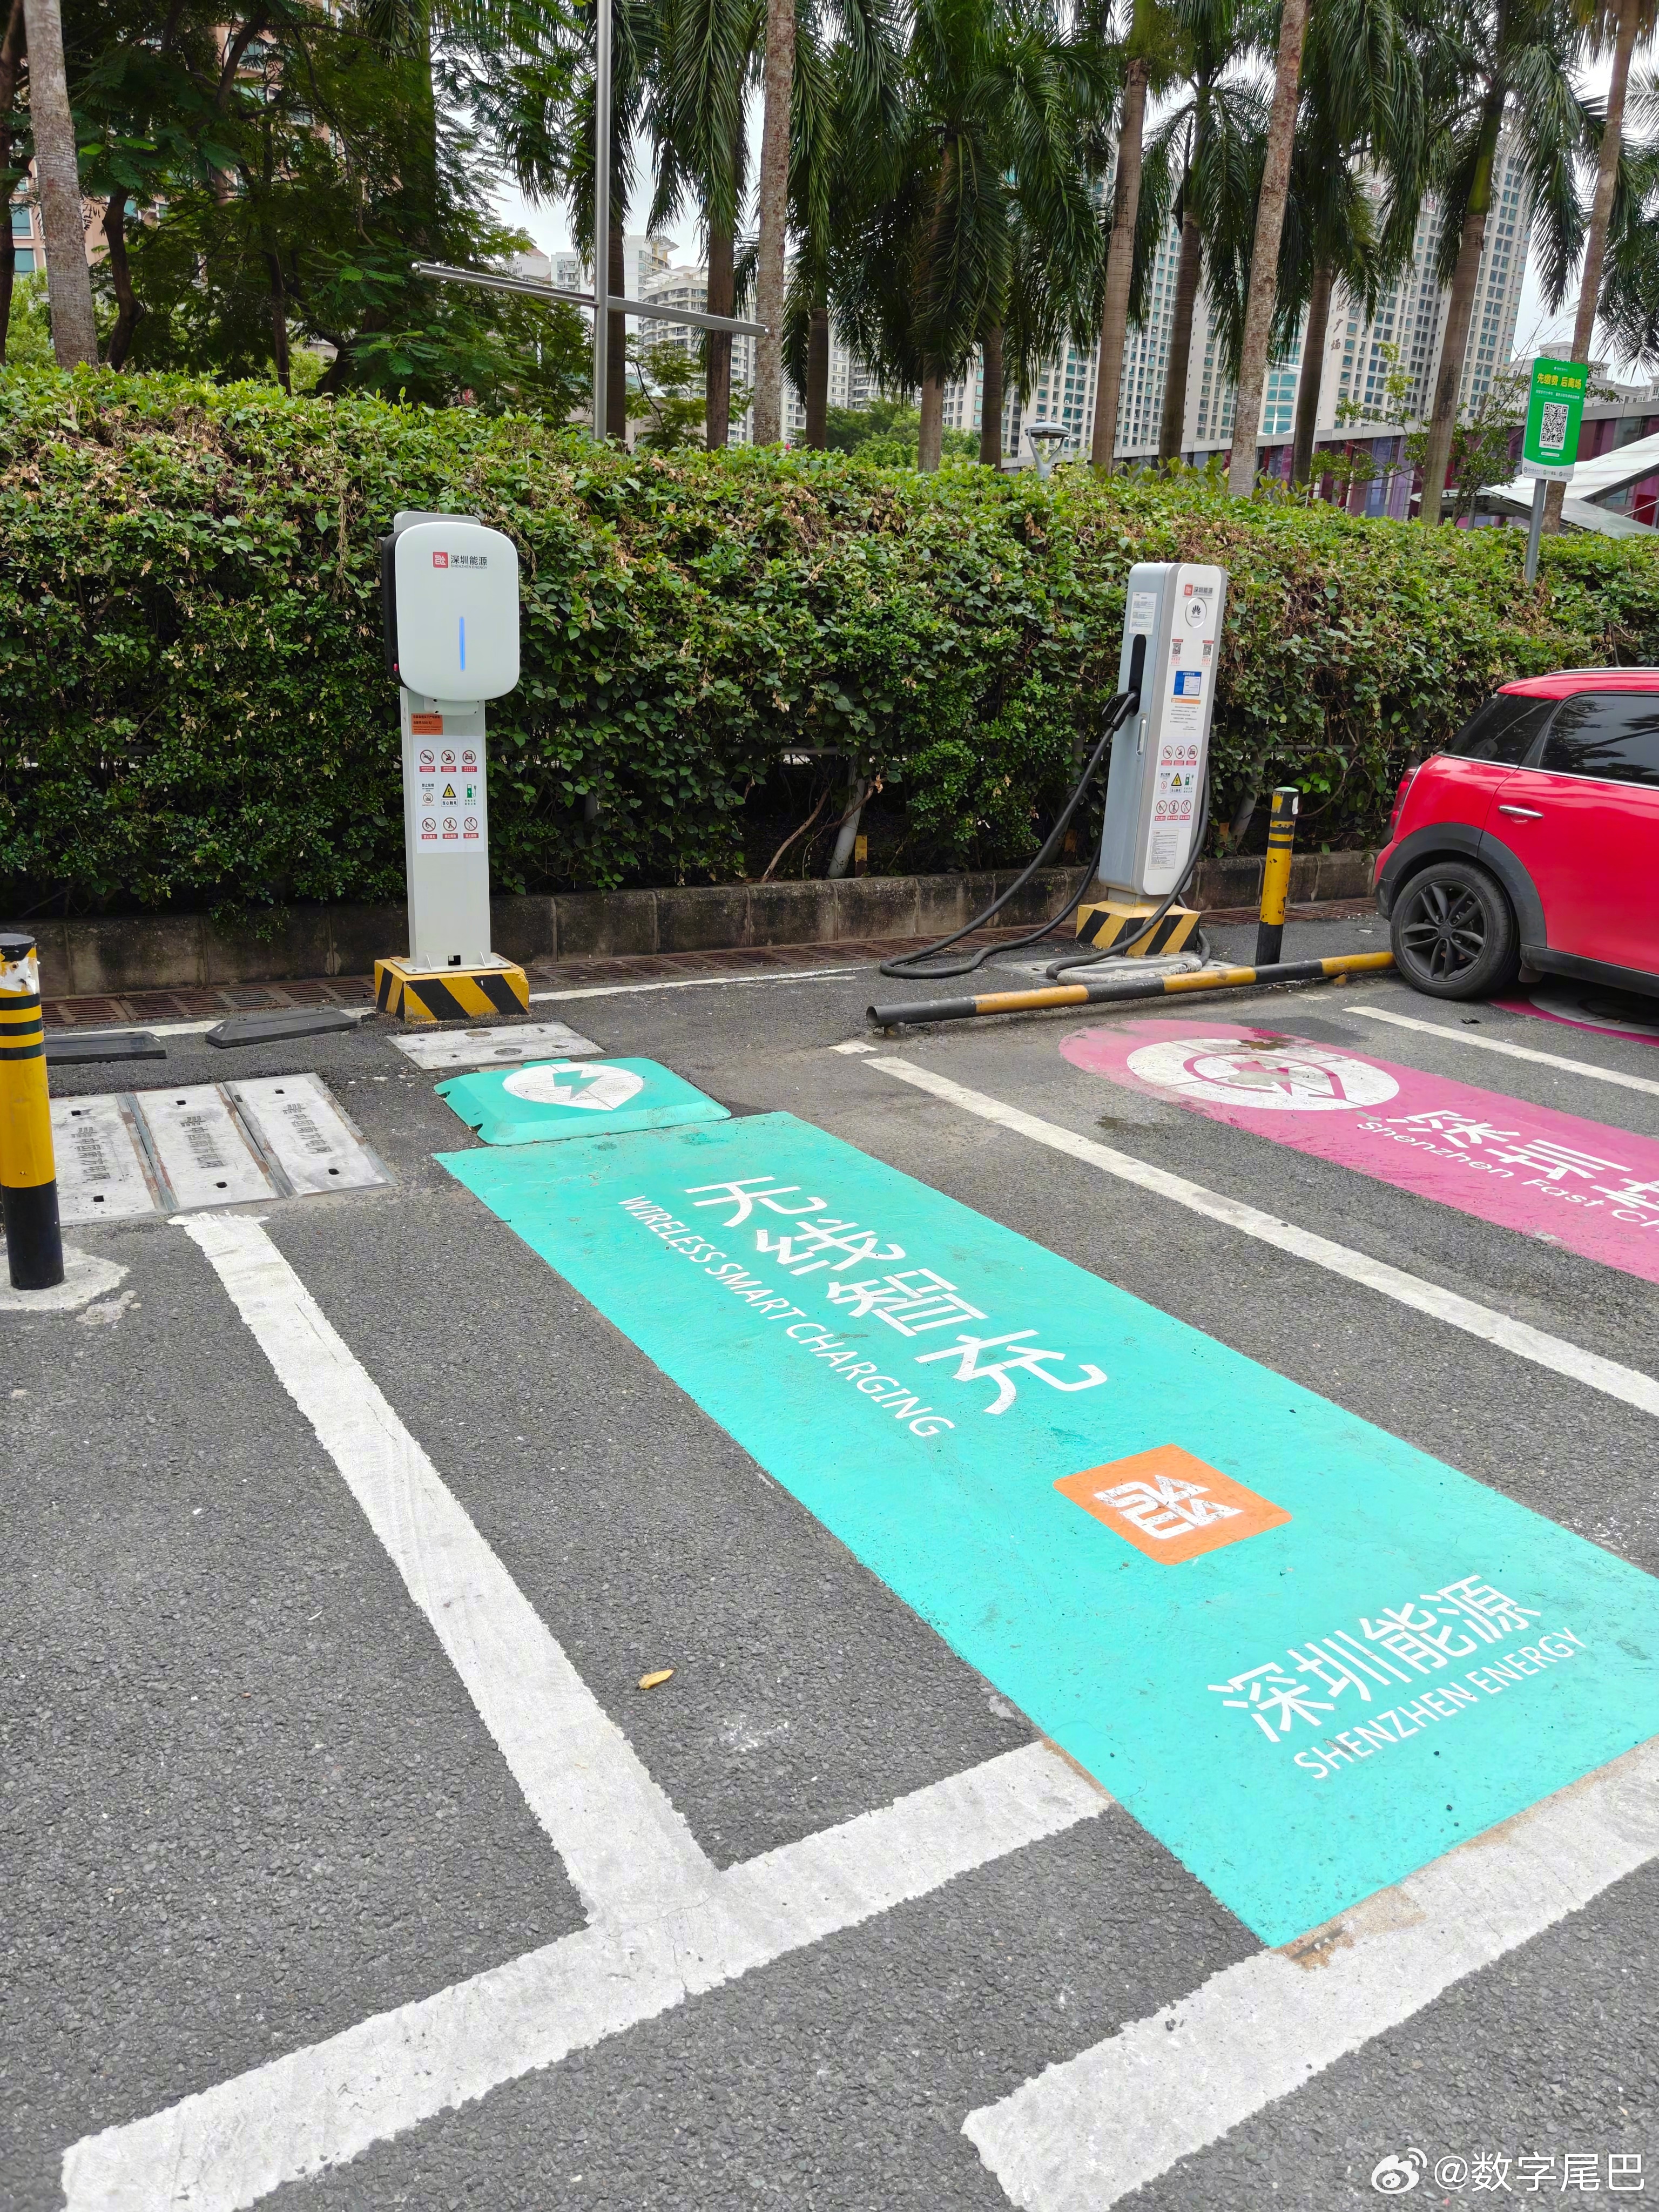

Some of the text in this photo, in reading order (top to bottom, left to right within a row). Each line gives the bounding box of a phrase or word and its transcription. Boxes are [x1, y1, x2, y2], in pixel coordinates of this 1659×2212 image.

[1561, 377, 1582, 389] 后离场
[451, 555, 487, 566] 深圳能源
[184, 1127, 224, 1168] 中国南方电网
[288, 1114, 332, 1154] 中国南方电网
[74, 1138, 111, 1181] 中国南方电网
[1357, 1122, 1515, 1178] Shenzhen
[1521, 1179, 1605, 1207] Fast
[618, 1196, 956, 1437] WIRELESS SMART CHARGING
[1208, 1575, 1541, 1742] 深圳能源
[1293, 1627, 1587, 1778] SHENZHEN ENERGY
